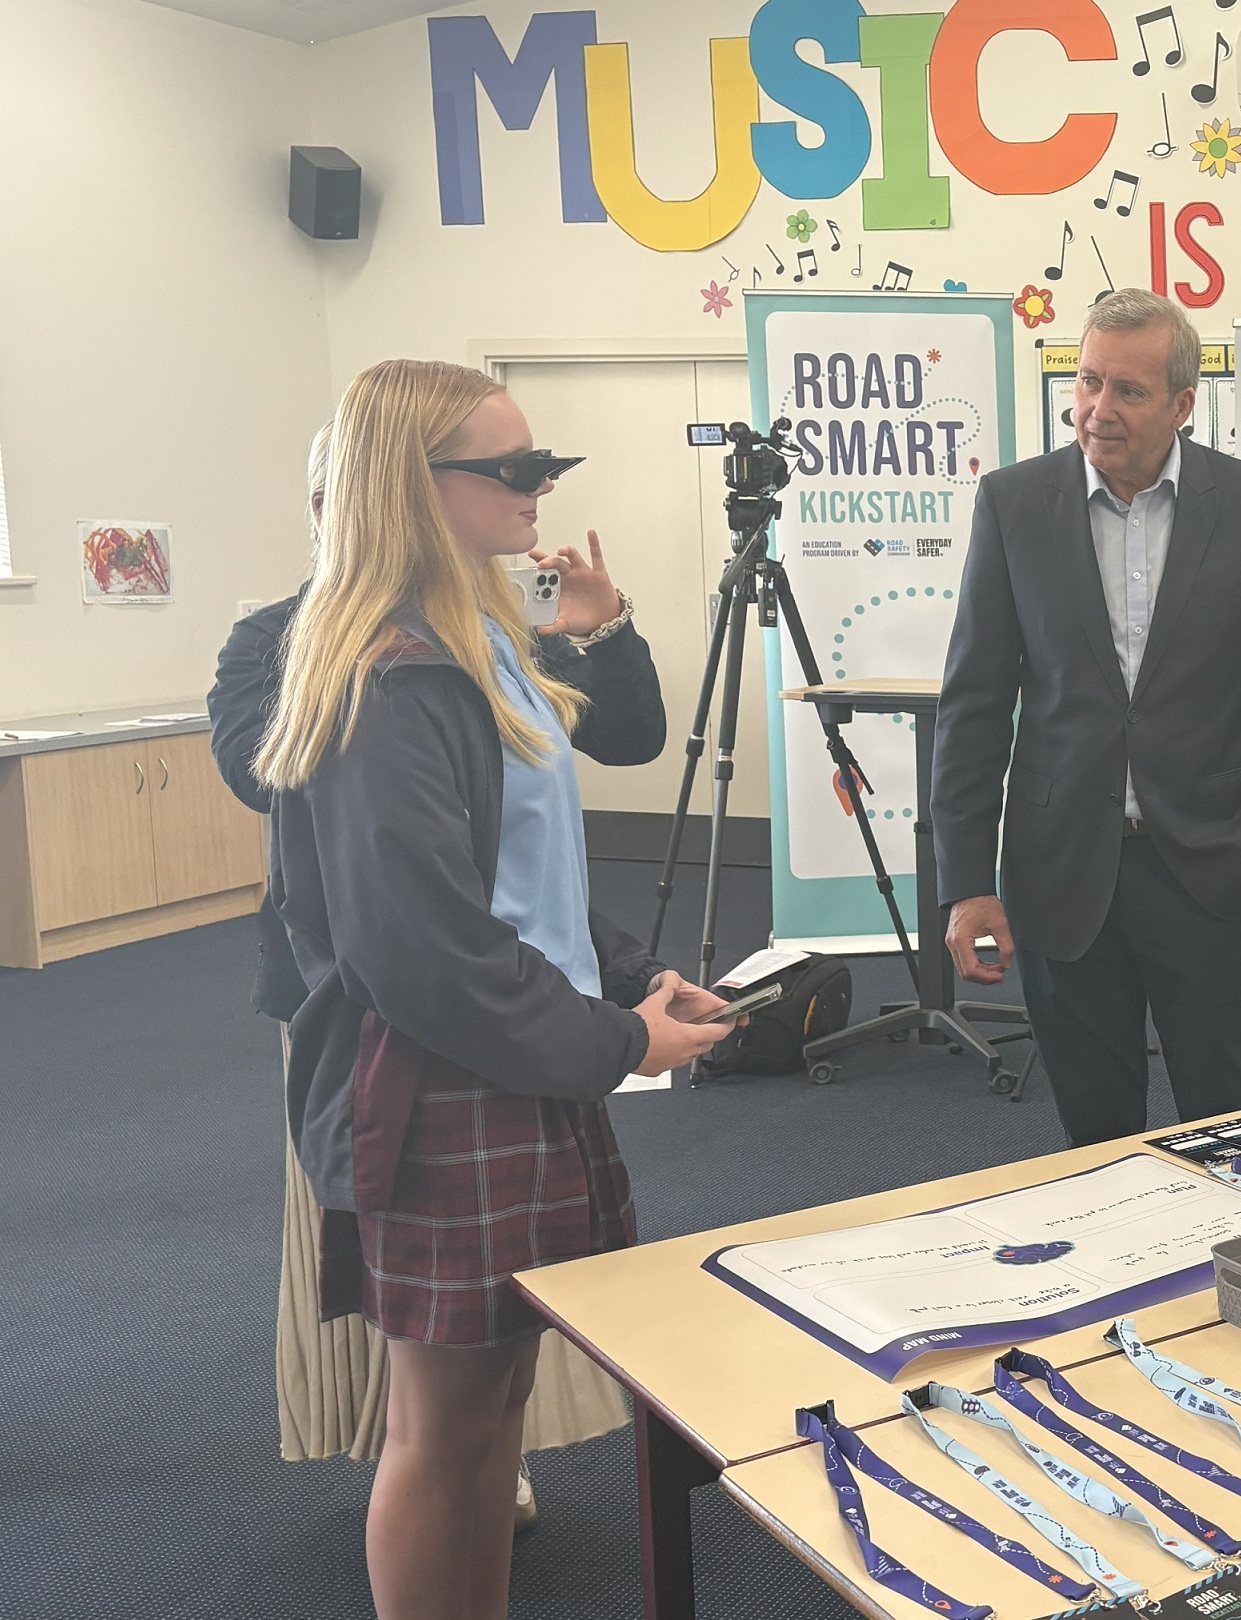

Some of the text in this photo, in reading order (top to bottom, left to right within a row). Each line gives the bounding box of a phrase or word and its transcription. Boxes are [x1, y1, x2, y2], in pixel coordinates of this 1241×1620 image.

[427, 0, 1118, 252] MUSIC
[1149, 202, 1225, 309] IS
[1046, 354, 1078, 364] Praise
[1200, 354, 1221, 364] God
[794, 352, 923, 409] ROAD
[795, 420, 965, 476] SMART
[800, 490, 954, 524] KICKSTART
[802, 549, 859, 557] PROGRAM DRIVEN BY
[917, 538, 952, 547] EVERYDAY
[1166, 1183, 1197, 1196] Plan
[939, 1245, 991, 1259] Impact
[1017, 1287, 1080, 1308] Solution
[901, 1330, 963, 1352] MIND MAP
[1185, 1589, 1220, 1607] ROAD
[1197, 1592, 1239, 1616] SMART
